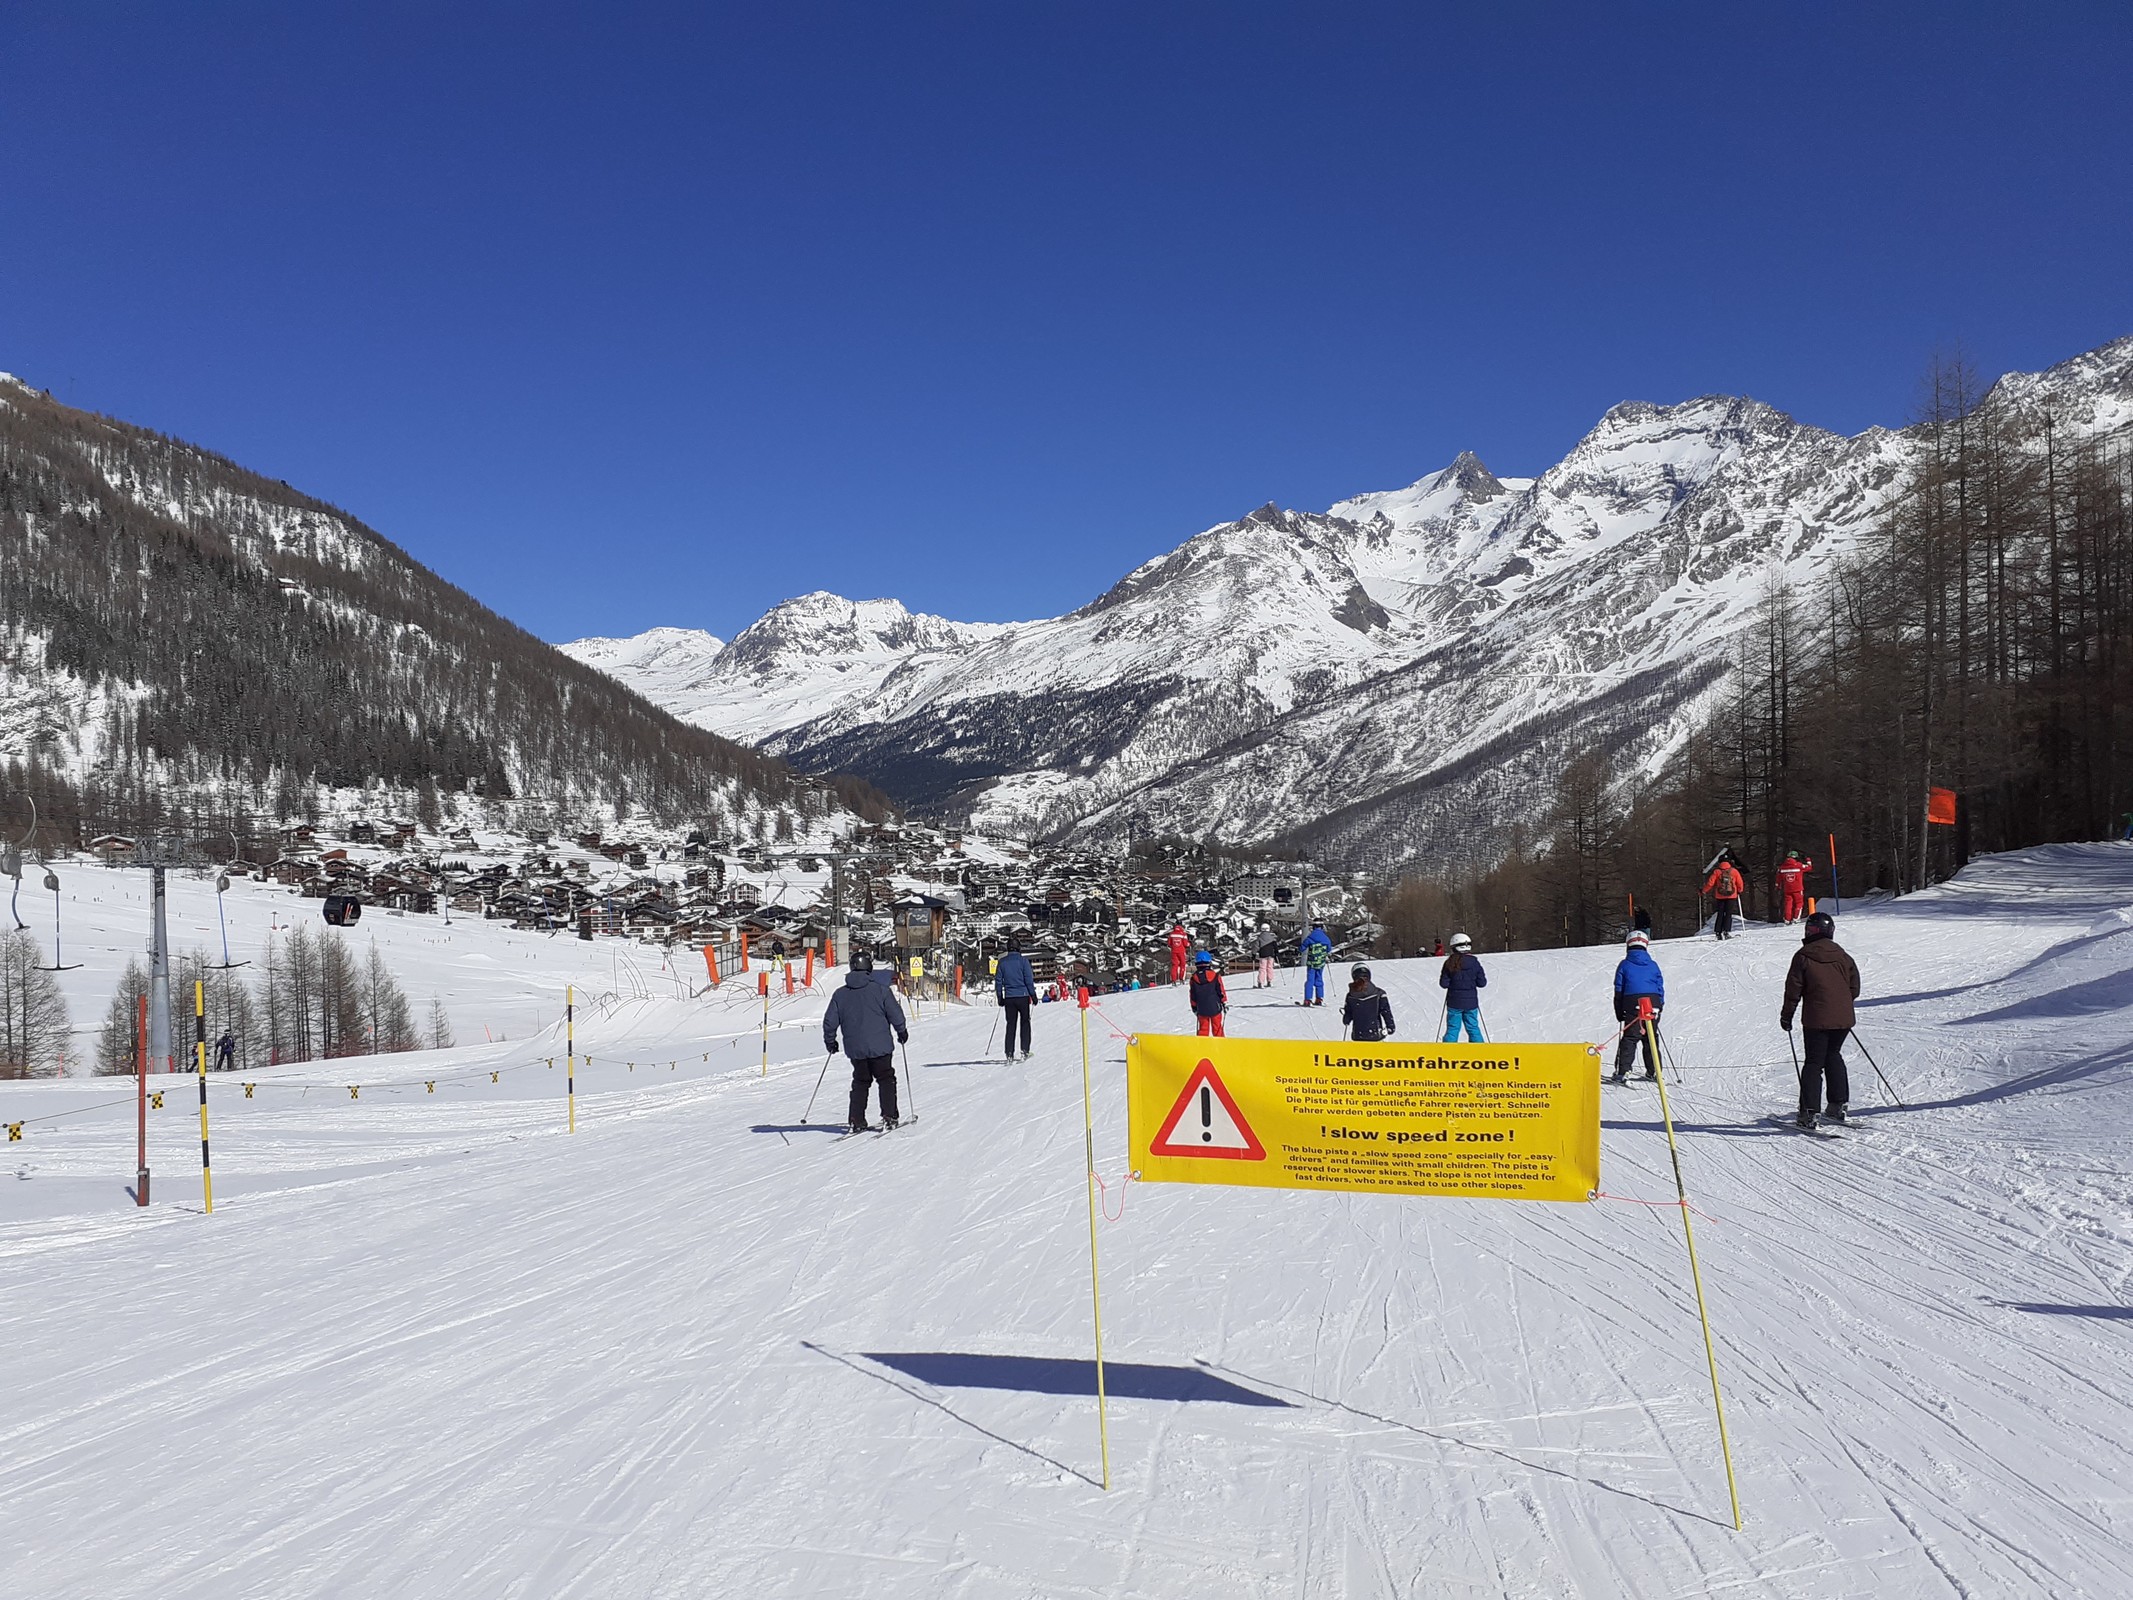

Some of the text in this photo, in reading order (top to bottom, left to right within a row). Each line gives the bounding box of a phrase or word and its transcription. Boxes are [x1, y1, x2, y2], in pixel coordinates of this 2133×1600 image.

[1275, 1076, 1312, 1085] Speziell
[1315, 1077, 1328, 1085] für
[1331, 1077, 1379, 1085] Geniesser
[1382, 1079, 1400, 1087] und
[1404, 1079, 1445, 1087] Familien
[1449, 1080, 1465, 1088] mit
[1507, 1080, 1546, 1088] Kindern
[1550, 1081, 1561, 1089] ist
[1285, 1085, 1298, 1093] die
[1302, 1086, 1328, 1094] blaue
[1331, 1087, 1354, 1095] Piste
[1358, 1088, 1370, 1096] als
[1287, 1095, 1550, 1109] Die Piste ist für gemütliche Fahrer reserviert. Schnelle
[1294, 1105, 1542, 1119] Fahrer werden gebeten andere Pisten zu benützen.
[1387, 1130, 1447, 1143] speed
[1282, 1144, 1299, 1152] The
[1302, 1145, 1322, 1153] blue
[1326, 1148, 1348, 1156] piste
[1392, 1151, 1421, 1159] speed
[1456, 1152, 1504, 1160] especially
[1508, 1152, 1521, 1160] for
[1331, 1157, 1348, 1165] and
[1351, 1158, 1389, 1166] families
[1392, 1159, 1413, 1167] with
[1417, 1160, 1443, 1168] small
[1446, 1161, 1488, 1169] children.
[1492, 1161, 1510, 1169] The
[1513, 1163, 1537, 1171] piste
[1541, 1162, 1549, 1170] is
[1284, 1164, 1324, 1172] reserved
[1327, 1165, 1340, 1173] for
[1344, 1166, 1376, 1174] slower
[1379, 1168, 1409, 1176] skiers.
[1413, 1169, 1432, 1177] The
[1435, 1171, 1460, 1179] slope
[1464, 1171, 1471, 1179] is
[1495, 1172, 1538, 1180] intended
[1542, 1173, 1555, 1181] for
[1296, 1172, 1312, 1180] fast
[1316, 1175, 1351, 1183] drivers,
[1354, 1176, 1375, 1184] who
[1397, 1179, 1425, 1187] asked
[1428, 1180, 1438, 1188] to
[1442, 1180, 1458, 1188] use
[1462, 1180, 1487, 1188] other
[1491, 1182, 1525, 1190] slopes.
